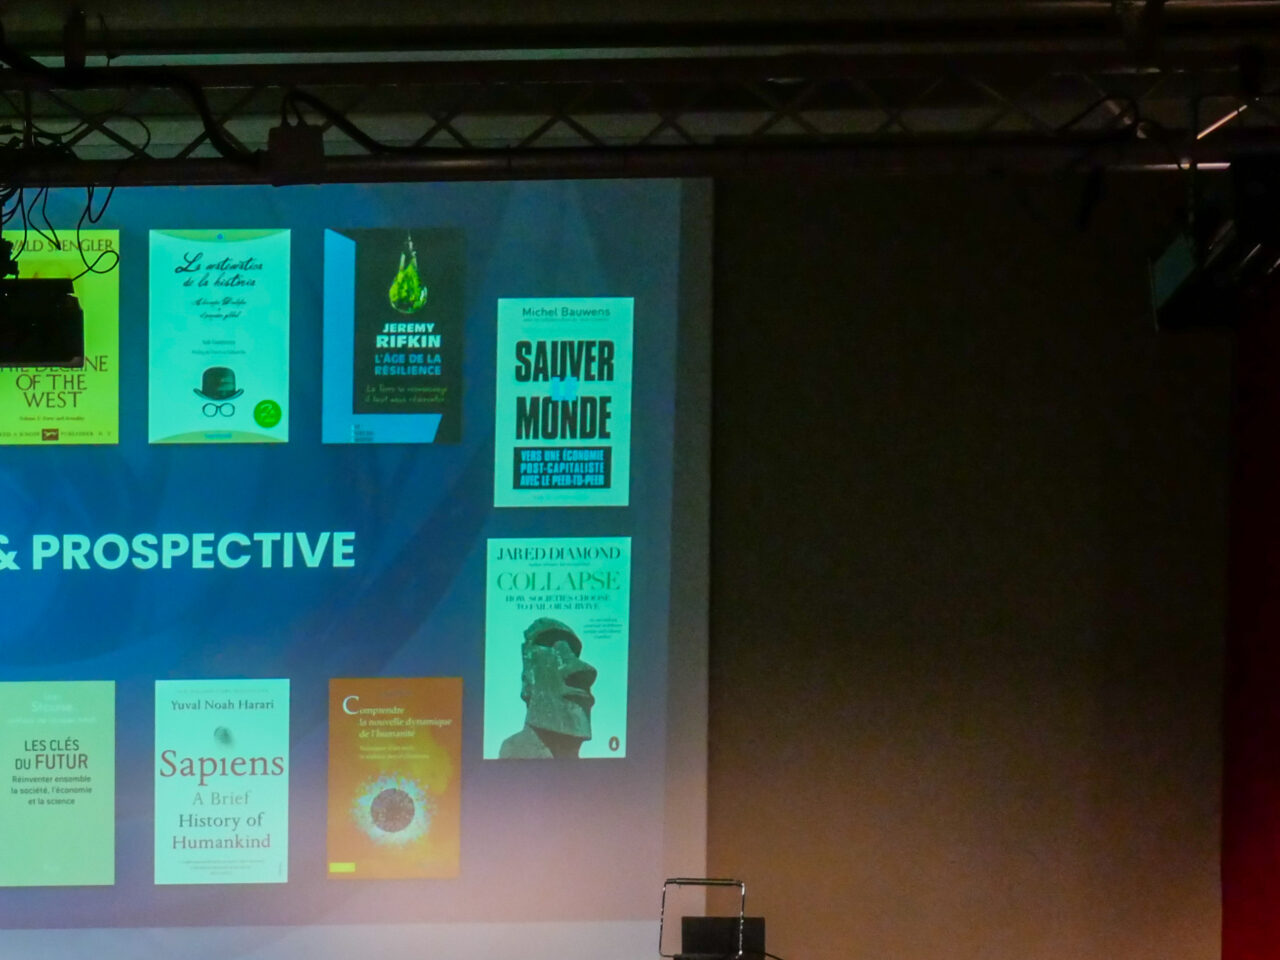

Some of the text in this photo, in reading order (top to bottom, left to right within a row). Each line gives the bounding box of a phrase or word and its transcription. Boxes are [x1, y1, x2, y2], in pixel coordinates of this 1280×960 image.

[522, 307, 611, 317] Michel Bauwens
[382, 323, 434, 332] JEREMY
[376, 335, 440, 348] RIFKIN
[409, 354, 424, 364] DE
[428, 354, 442, 364] LA
[515, 340, 614, 382] SAUVER
[375, 364, 441, 375] RÉSILIENCE
[16, 374, 87, 390] OF THE
[552, 376, 578, 401] LE
[24, 392, 82, 408] WEST
[516, 396, 612, 440] MONDE
[521, 450, 542, 461] VERS
[544, 450, 560, 461] UNE
[520, 462, 604, 474] POST-CAPITALISTE
[520, 474, 540, 486] AVEC
[541, 474, 550, 486] LE
[32, 532, 356, 570] PROSPECTIVE
[497, 546, 620, 560] JARED DIAMOND
[497, 571, 620, 591] COLLAPSE
[171, 700, 274, 710] Yuval Noah Harari
[360, 718, 367, 726] la
[359, 730, 370, 738] de
[25, 736, 80, 751] LES CLÉS
[15, 754, 88, 770] DU FUTUR
[160, 750, 284, 786] Sapiens
[192, 791, 250, 806] A Brief
[179, 812, 264, 831] History of
[172, 834, 271, 849] Humankind
